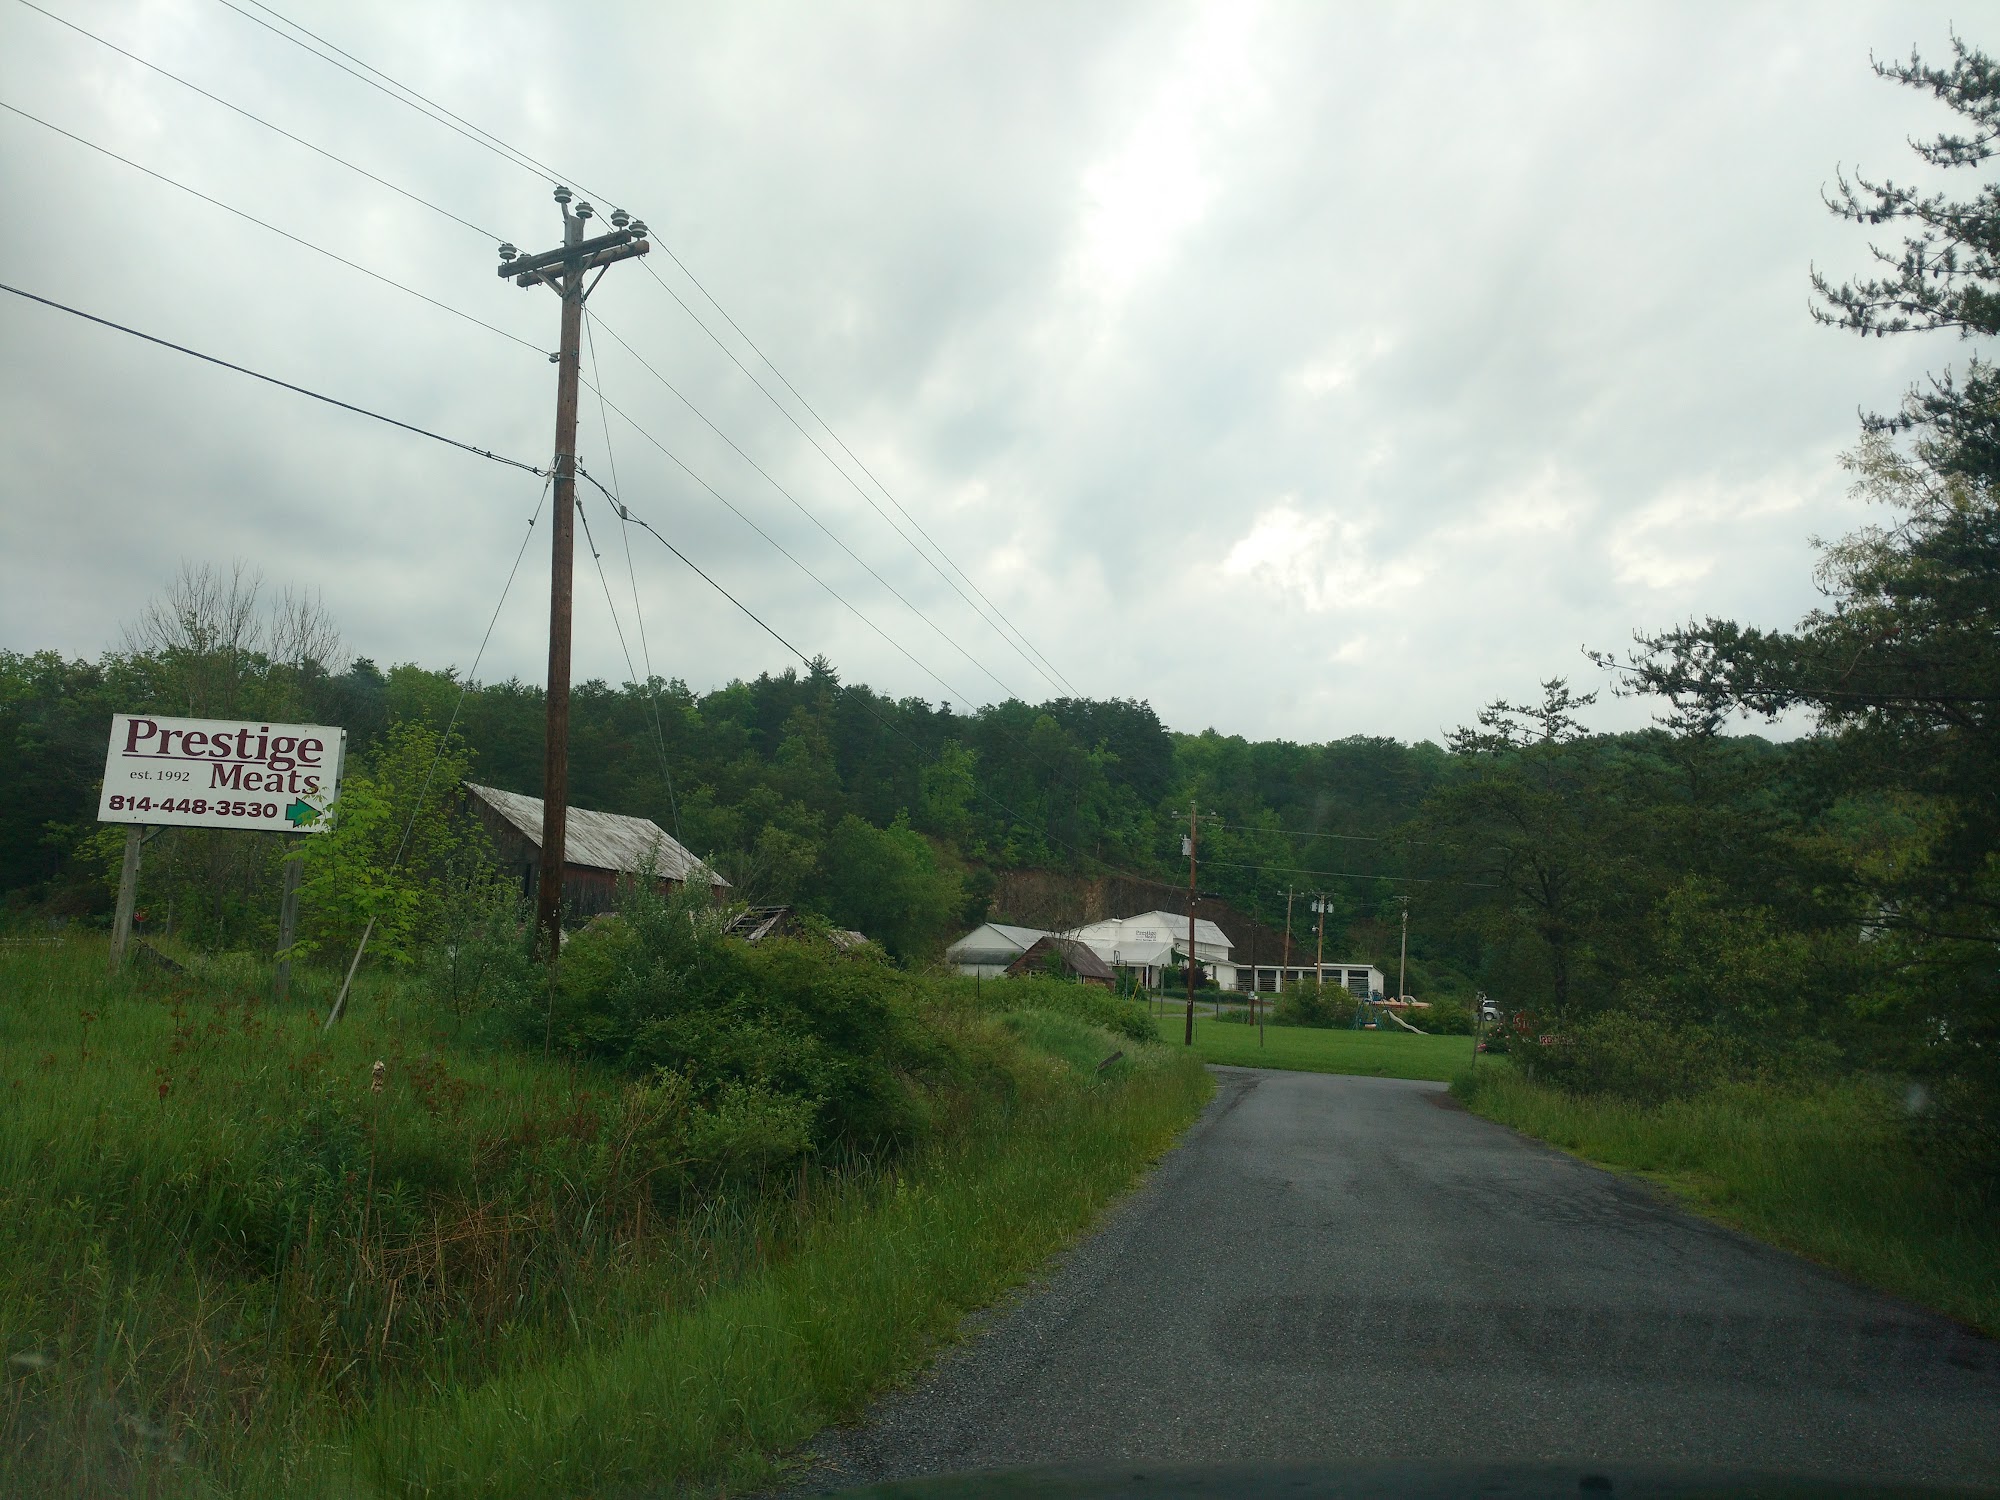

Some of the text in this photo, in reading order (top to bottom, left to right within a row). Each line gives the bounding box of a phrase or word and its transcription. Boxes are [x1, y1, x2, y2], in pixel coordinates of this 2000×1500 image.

[123, 718, 324, 770] Prestige
[130, 771, 191, 783] est. 1992
[209, 763, 322, 794] Meats
[108, 795, 278, 818] 814-448-3530
